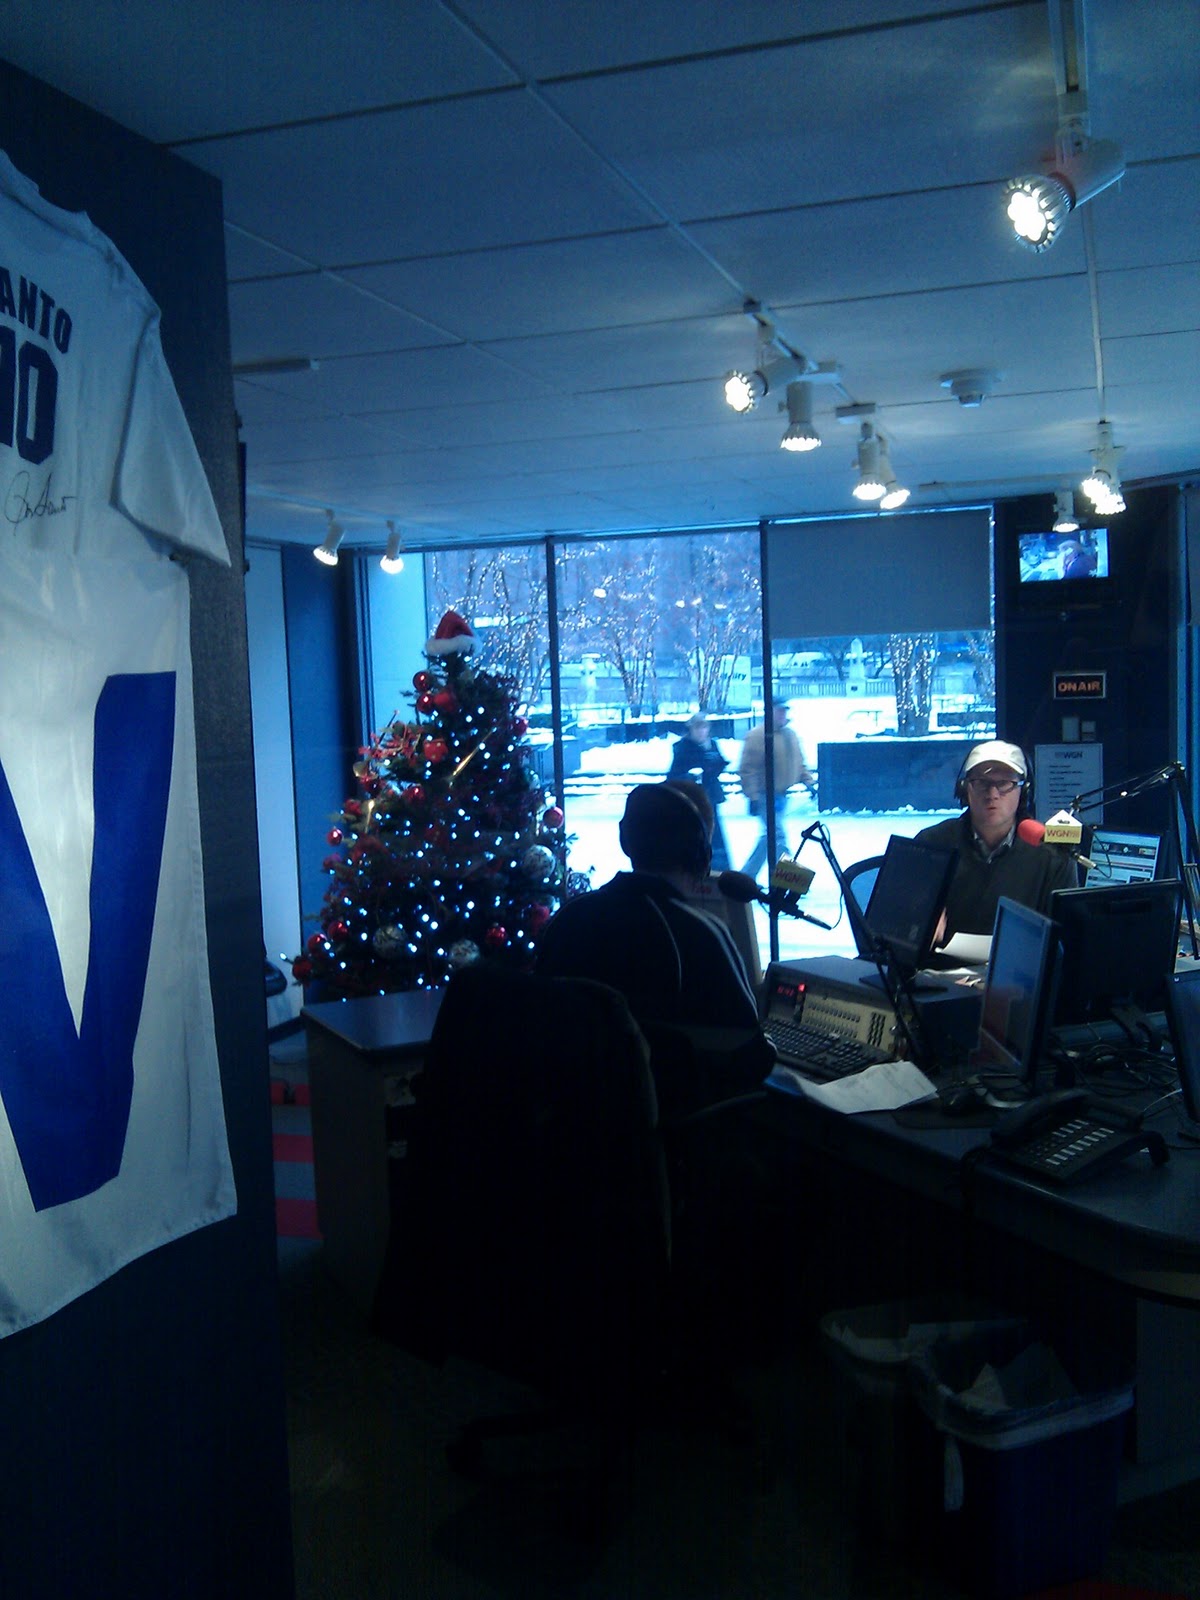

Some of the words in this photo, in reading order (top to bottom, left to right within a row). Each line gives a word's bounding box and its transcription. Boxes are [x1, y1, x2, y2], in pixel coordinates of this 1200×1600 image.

[1058, 682, 1077, 692] ON
[1078, 681, 1101, 691] AIR
[1046, 829, 1070, 838] WGN
